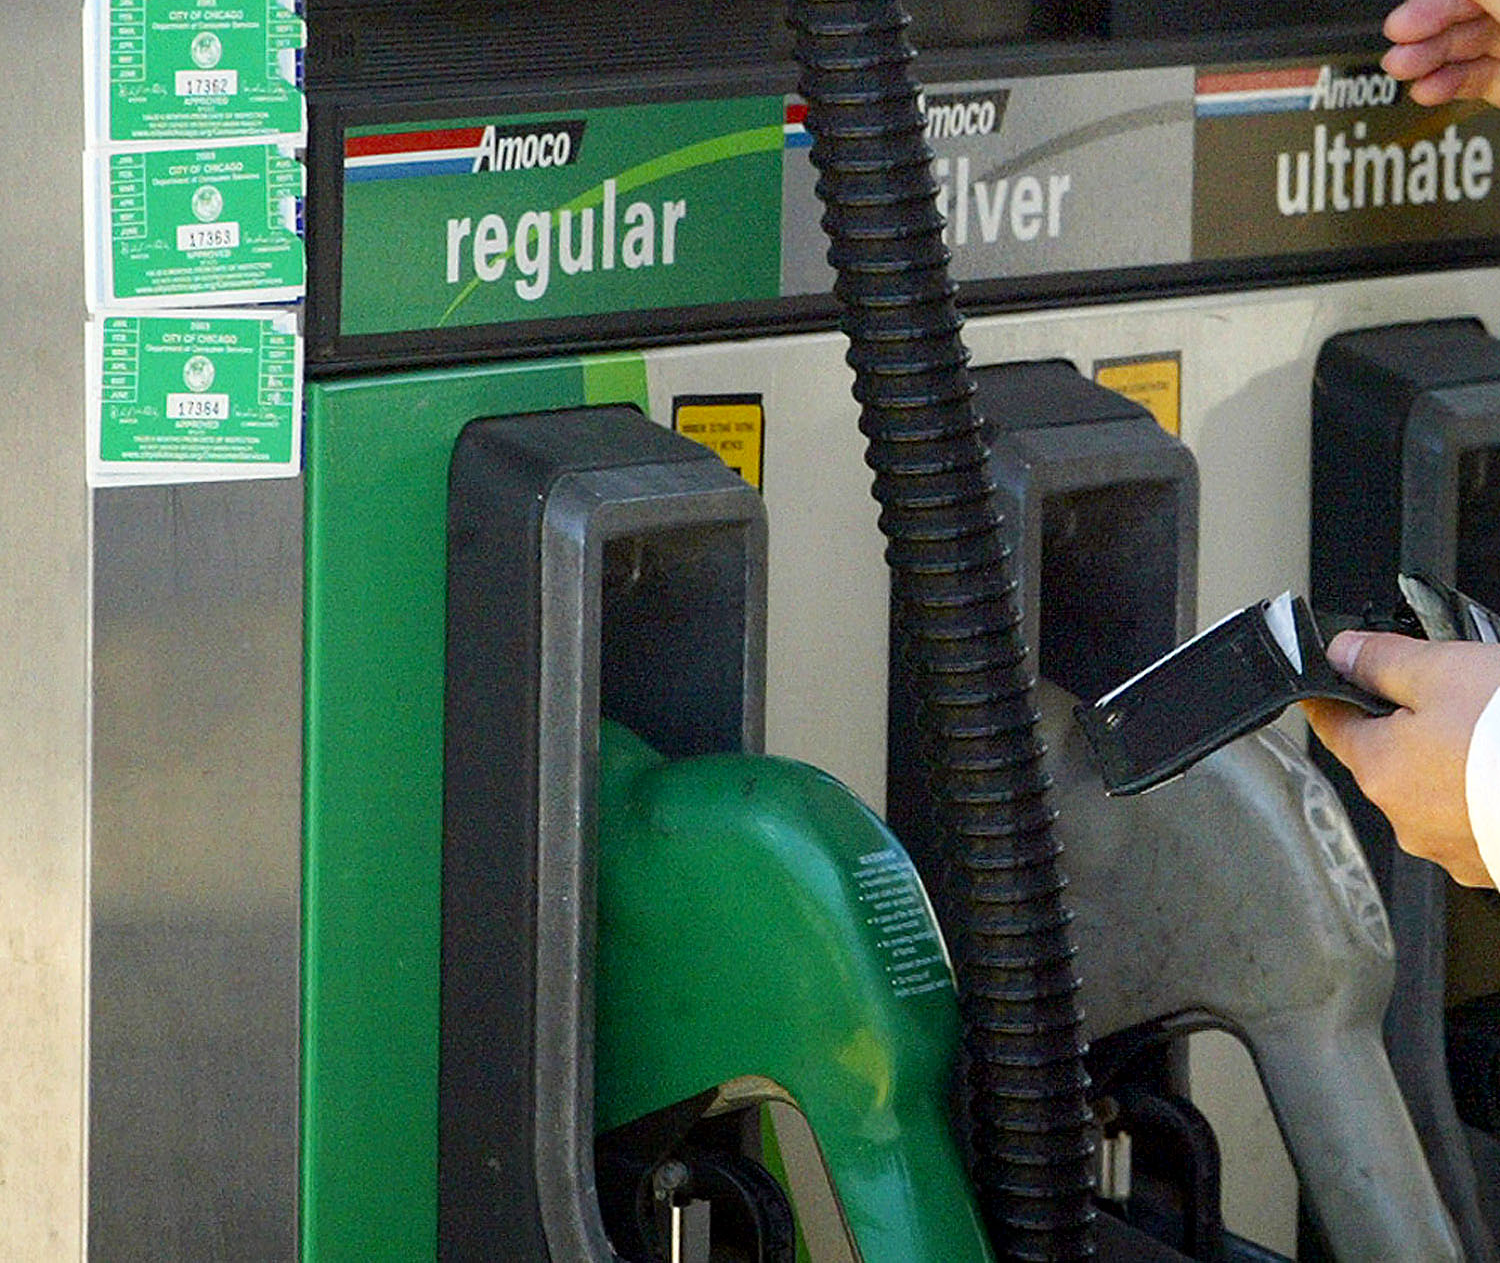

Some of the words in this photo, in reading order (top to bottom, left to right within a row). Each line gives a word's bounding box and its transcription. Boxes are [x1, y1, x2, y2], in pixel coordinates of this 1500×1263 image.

[169, 10, 188, 20] CITY
[190, 10, 202, 20] OF
[204, 10, 244, 20] CHICAGO
[1309, 64, 1397, 111] Amoco
[916, 91, 996, 140] moco
[169, 165, 188, 175] CITY
[190, 164, 202, 174] OF
[204, 162, 244, 173] CHICAGO
[472, 125, 570, 173] Amoco
[1277, 121, 1494, 216] ultimate
[936, 156, 1071, 247] ilver
[446, 178, 686, 301] regular
[162, 333, 181, 343] CITY
[183, 334, 195, 343] OF
[198, 334, 238, 344] CHICAGO
